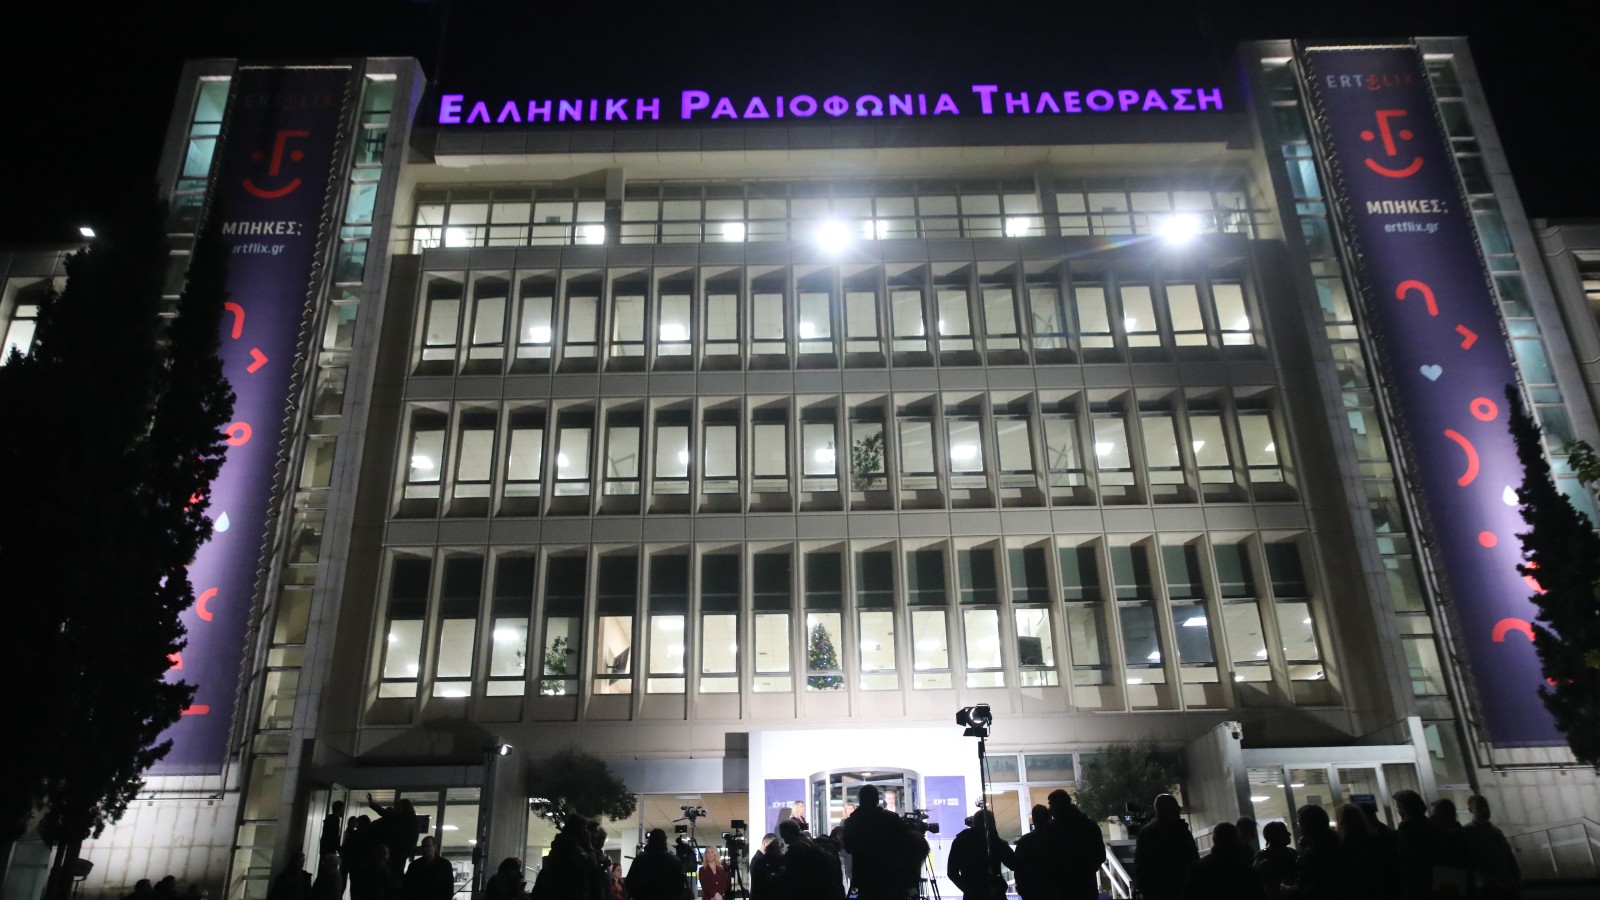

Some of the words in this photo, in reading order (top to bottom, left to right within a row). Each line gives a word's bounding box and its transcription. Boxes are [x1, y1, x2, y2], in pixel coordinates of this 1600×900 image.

[438, 93, 661, 124] ΕΛΛΗΝΙΚΗ
[680, 89, 961, 119] ΡΑΔΙΟΦΩΝΙΑ
[971, 84, 1224, 114] ΤΗΛΕΟΡΑΣΗ
[1383, 220, 1440, 234] ertflix.gr
